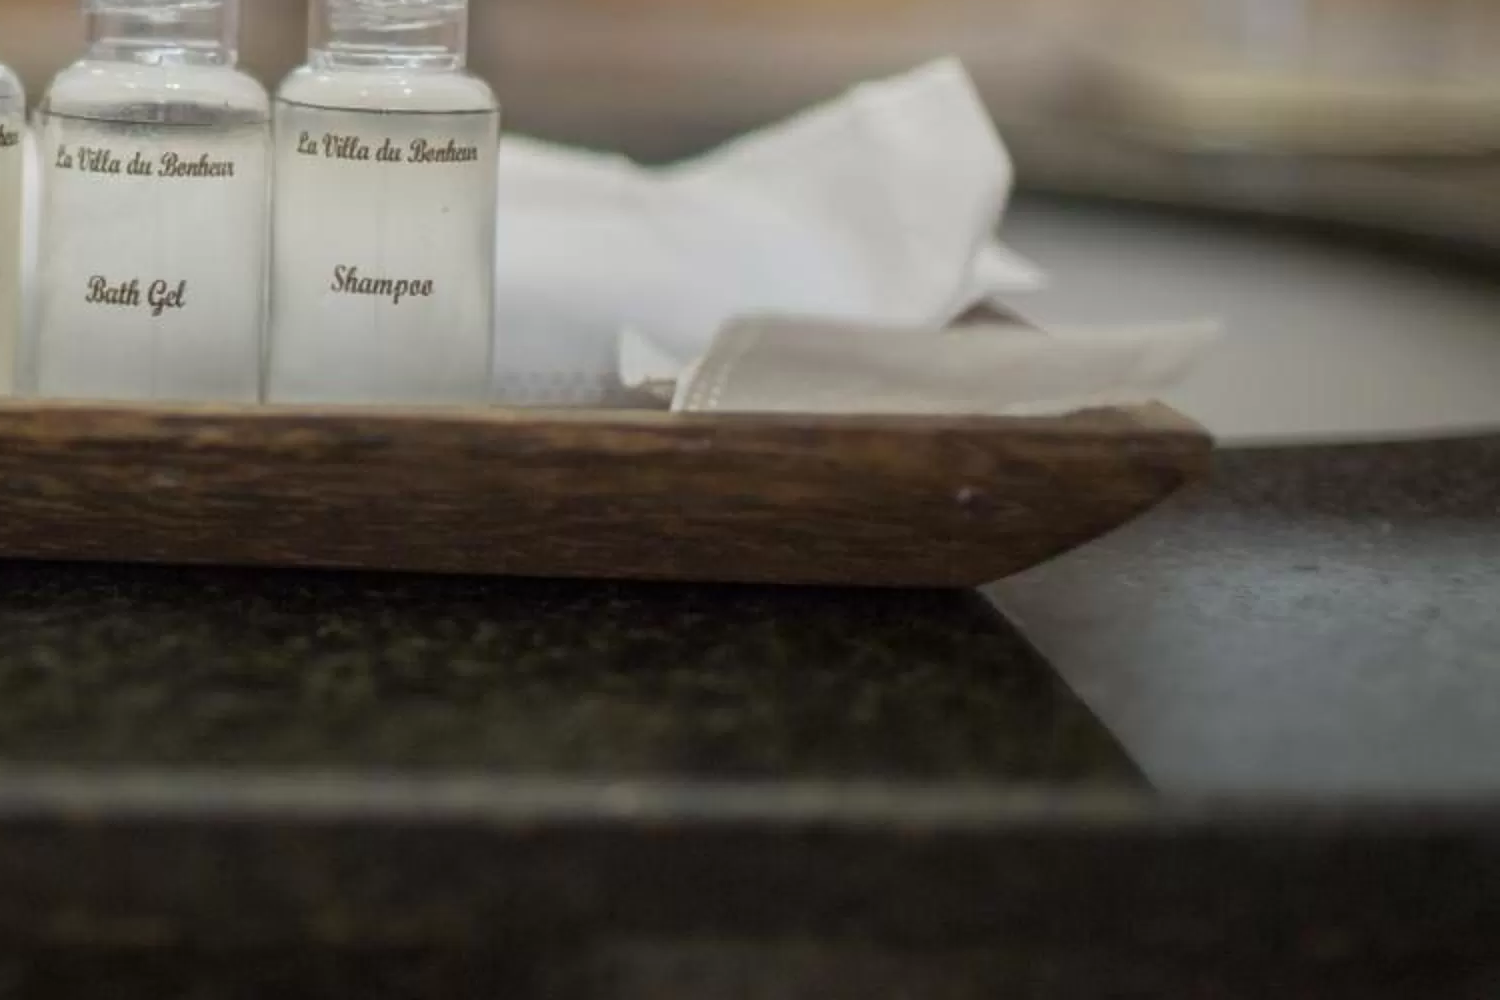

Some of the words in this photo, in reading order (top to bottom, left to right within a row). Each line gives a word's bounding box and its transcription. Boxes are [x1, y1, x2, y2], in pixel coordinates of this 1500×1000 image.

[55, 144, 73, 169] La
[76, 147, 121, 174] Villa
[126, 152, 153, 176] du
[157, 152, 235, 177] Bonheur
[297, 131, 318, 155] La
[322, 132, 369, 161] Villa
[375, 138, 401, 162] du
[407, 138, 478, 163] Bonheur
[84, 275, 141, 306] Bath
[147, 279, 187, 317] Gel
[330, 264, 434, 305] Shampoo
